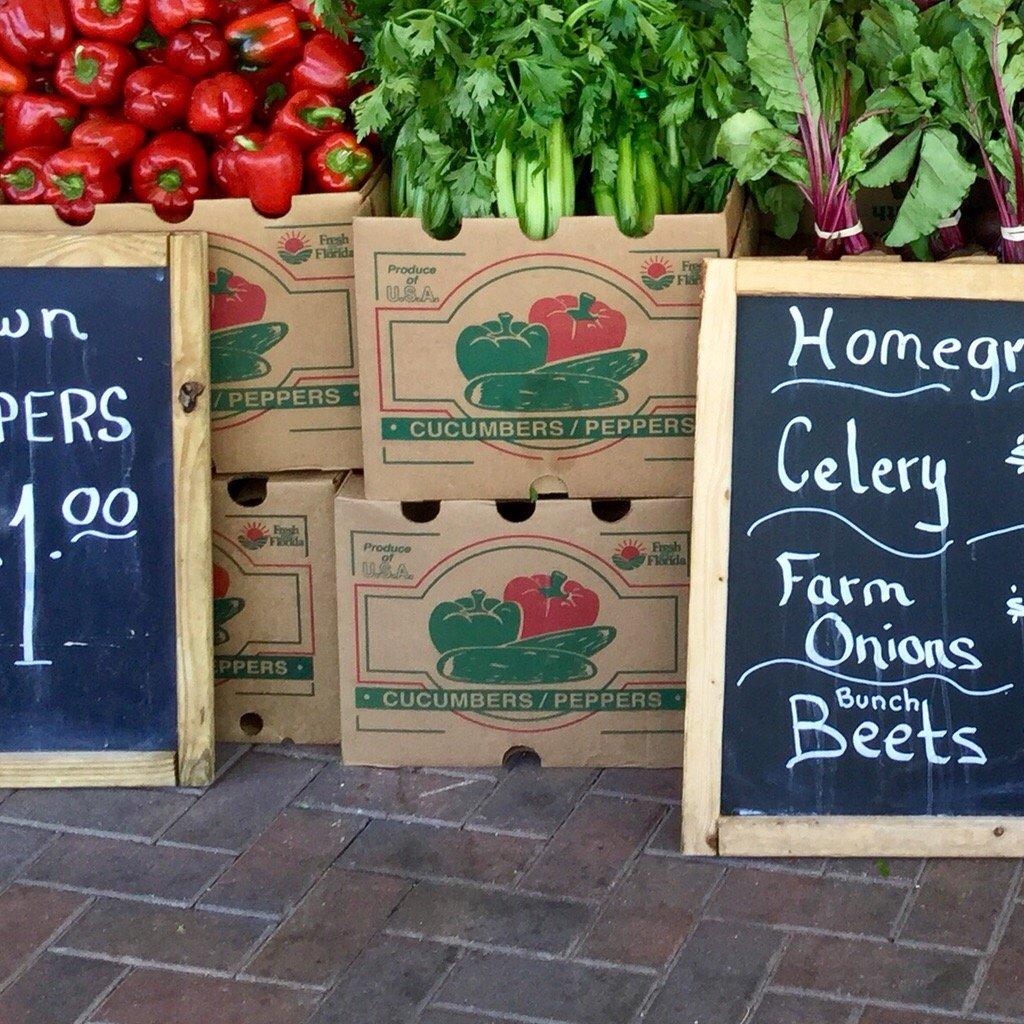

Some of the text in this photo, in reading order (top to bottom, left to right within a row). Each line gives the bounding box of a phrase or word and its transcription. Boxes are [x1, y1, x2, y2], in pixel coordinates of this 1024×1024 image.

[388, 264, 437, 275] Produce
[406, 275, 419, 285] of
[229, 388, 341, 408] PEPPERS
[410, 421, 564, 439] CUCUMBERS
[585, 418, 695, 437] PEPPERS
[778, 416, 948, 532] Celery
[363, 542, 412, 554] Produce
[647, 555, 687, 566] Florida
[776, 552, 914, 606] Farm
[805, 612, 982, 670] Onions
[382, 690, 533, 709] CUCUMBERS
[554, 691, 662, 709] PEPPERS
[836, 687, 921, 713] Bunch
[786, 694, 988, 769] Beets
